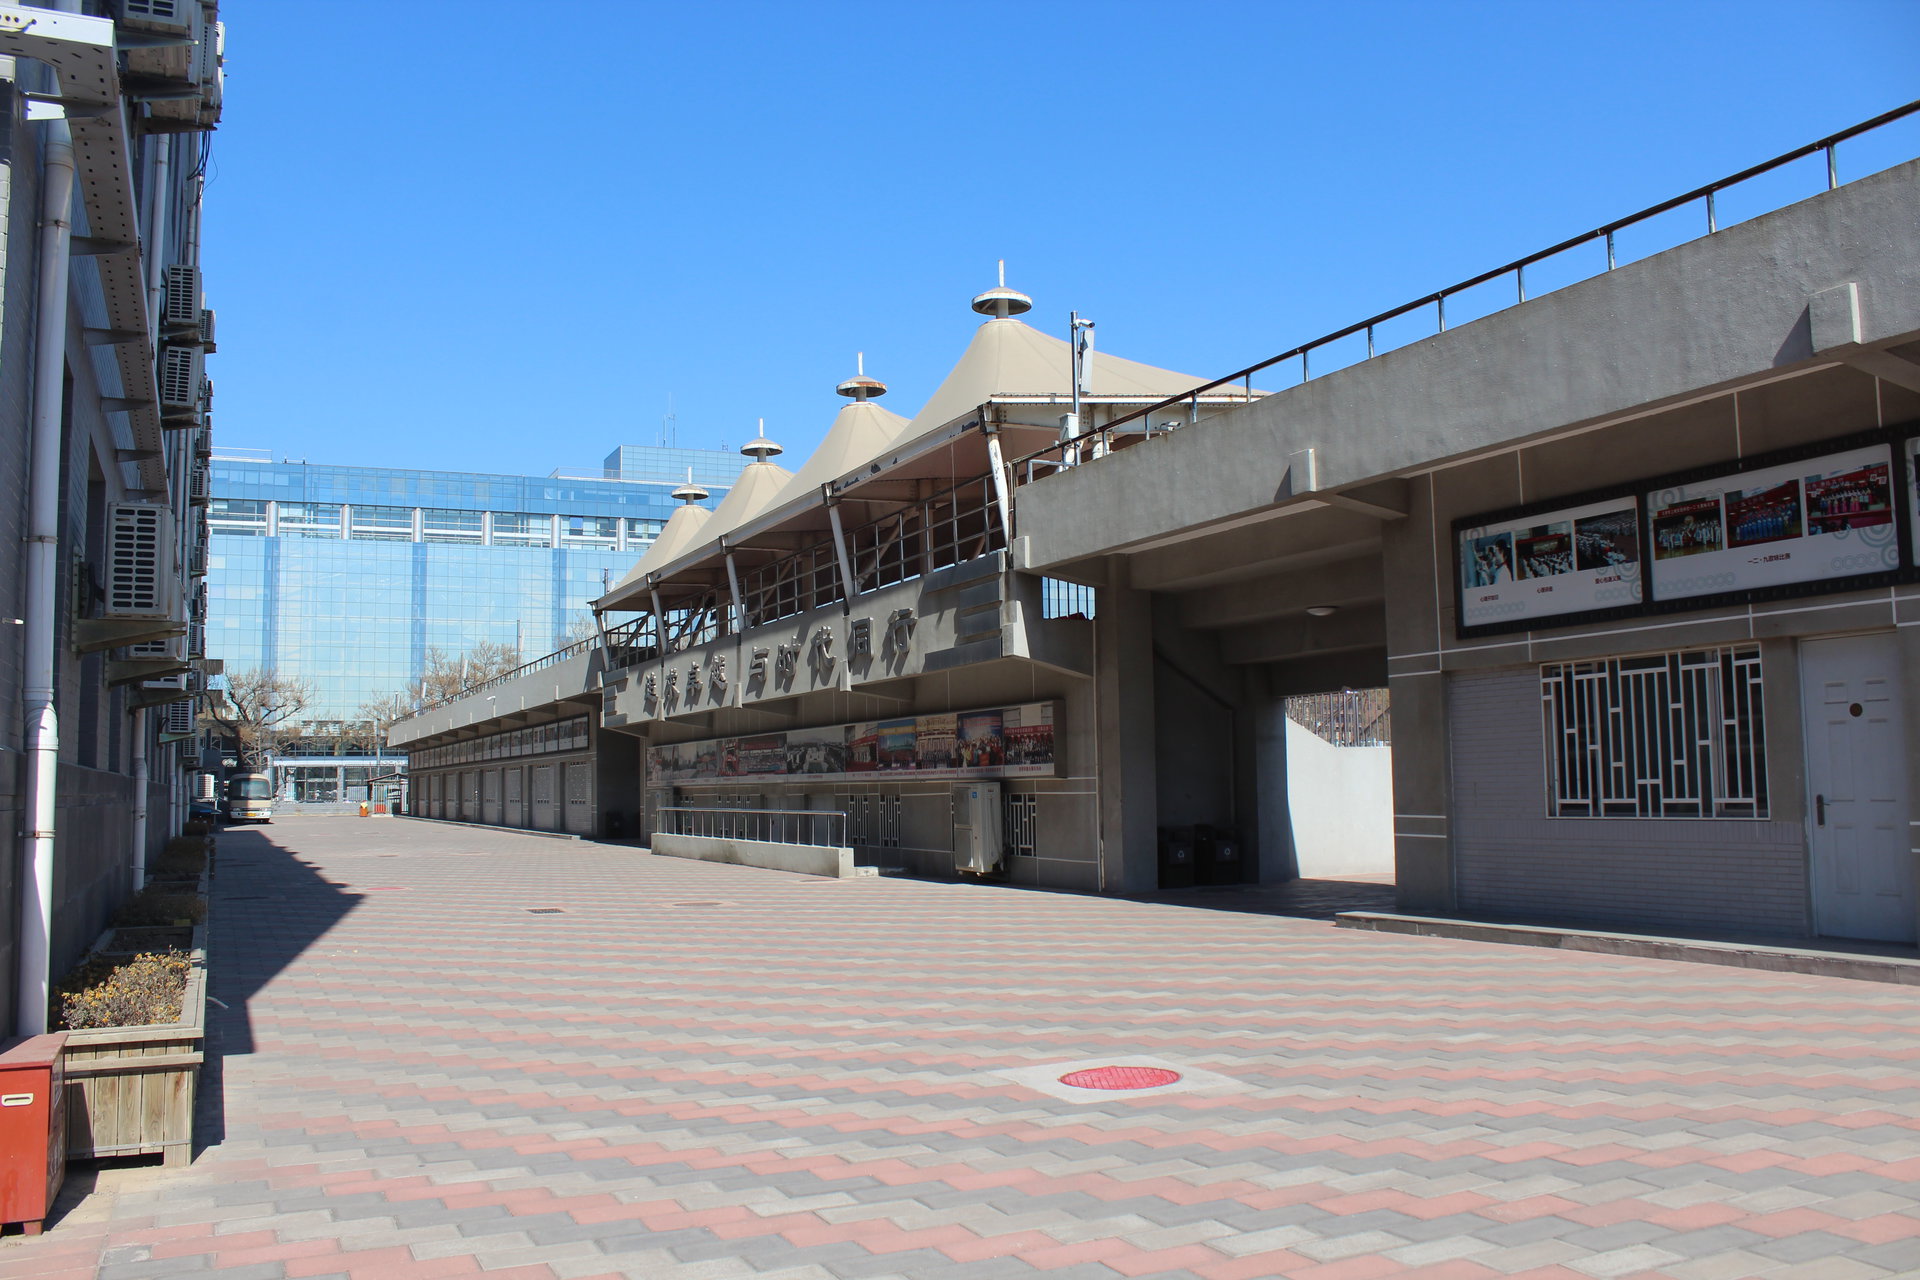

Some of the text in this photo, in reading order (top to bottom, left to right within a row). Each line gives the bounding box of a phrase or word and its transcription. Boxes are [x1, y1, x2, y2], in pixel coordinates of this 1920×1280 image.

[646, 608, 919, 703] 追求卓越 与时代同行
